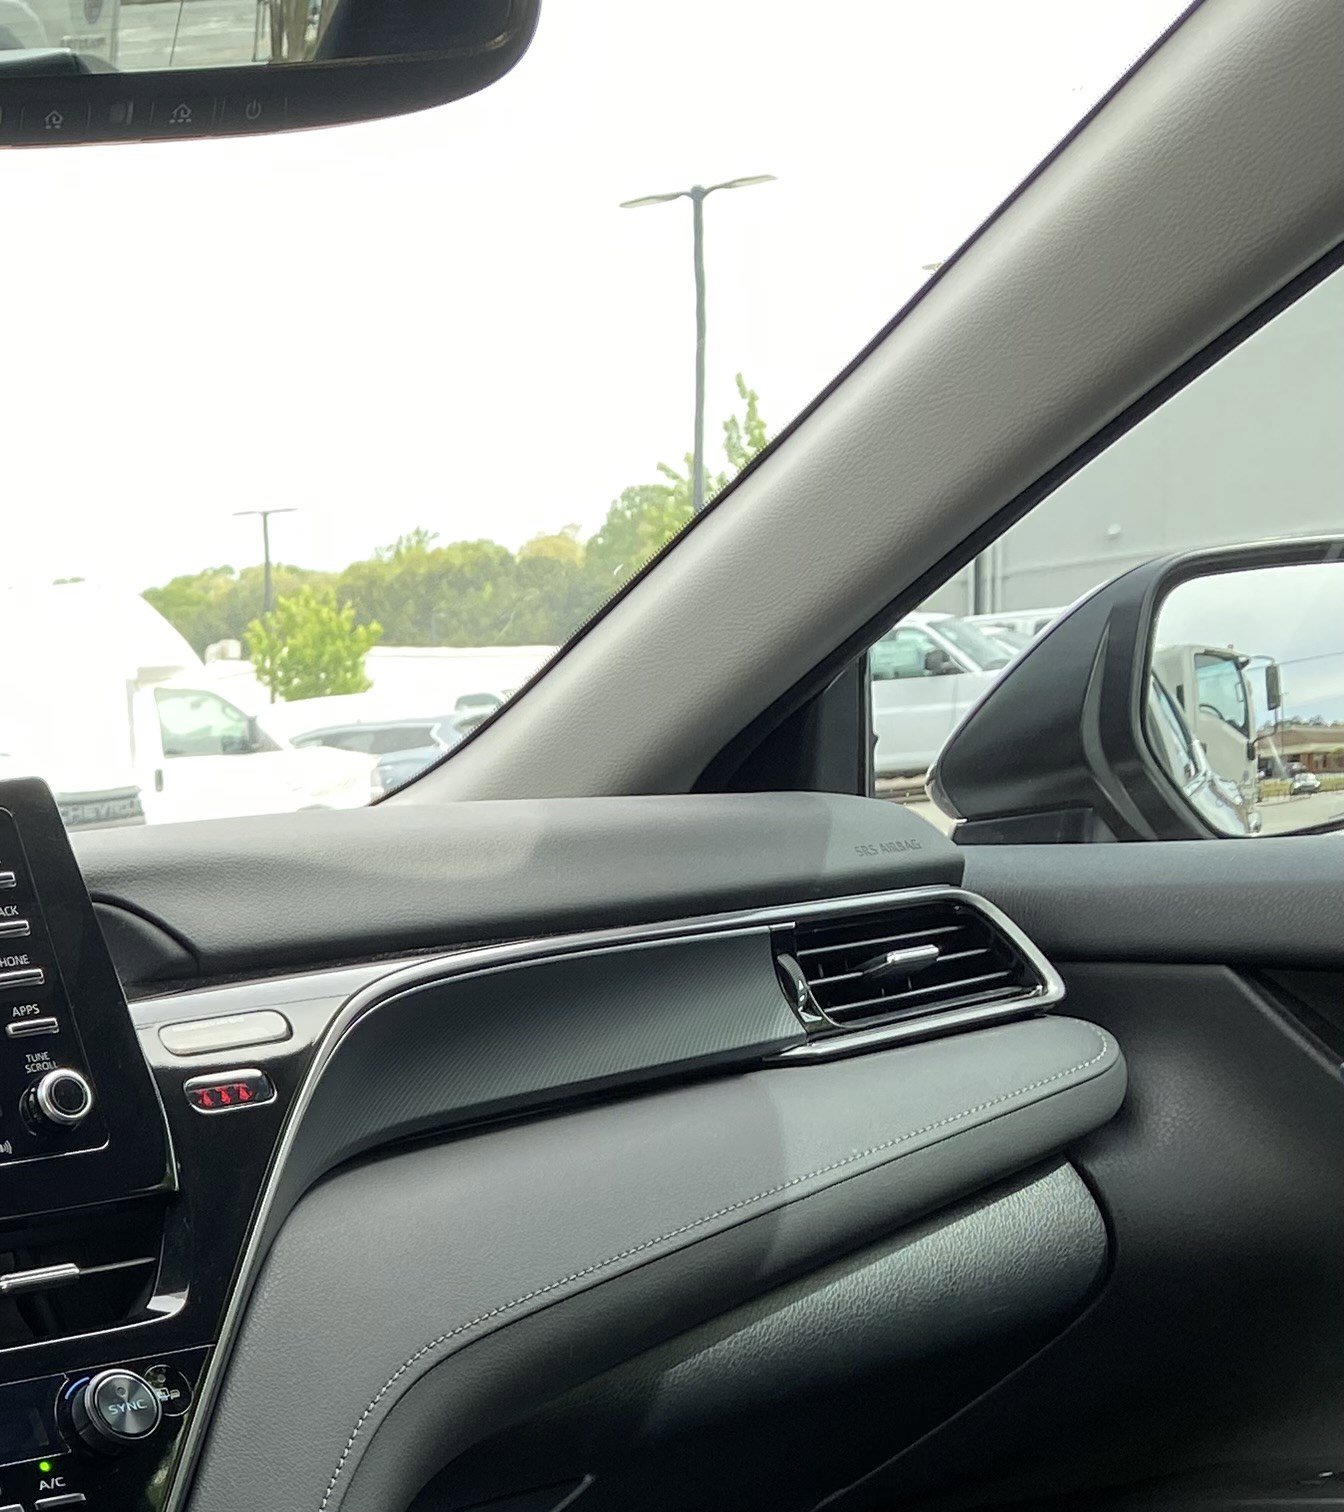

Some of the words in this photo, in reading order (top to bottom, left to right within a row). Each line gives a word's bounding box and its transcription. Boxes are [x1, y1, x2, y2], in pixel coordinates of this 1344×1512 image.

[854, 844, 879, 857] SRS
[879, 839, 922, 854] AIRBAG
[12, 1003, 40, 1018] APPS
[25, 1051, 50, 1063] TUNE
[24, 1060, 58, 1074] SCROLL
[108, 1399, 148, 1415] SYNC
[39, 1476, 67, 1491] A/C
